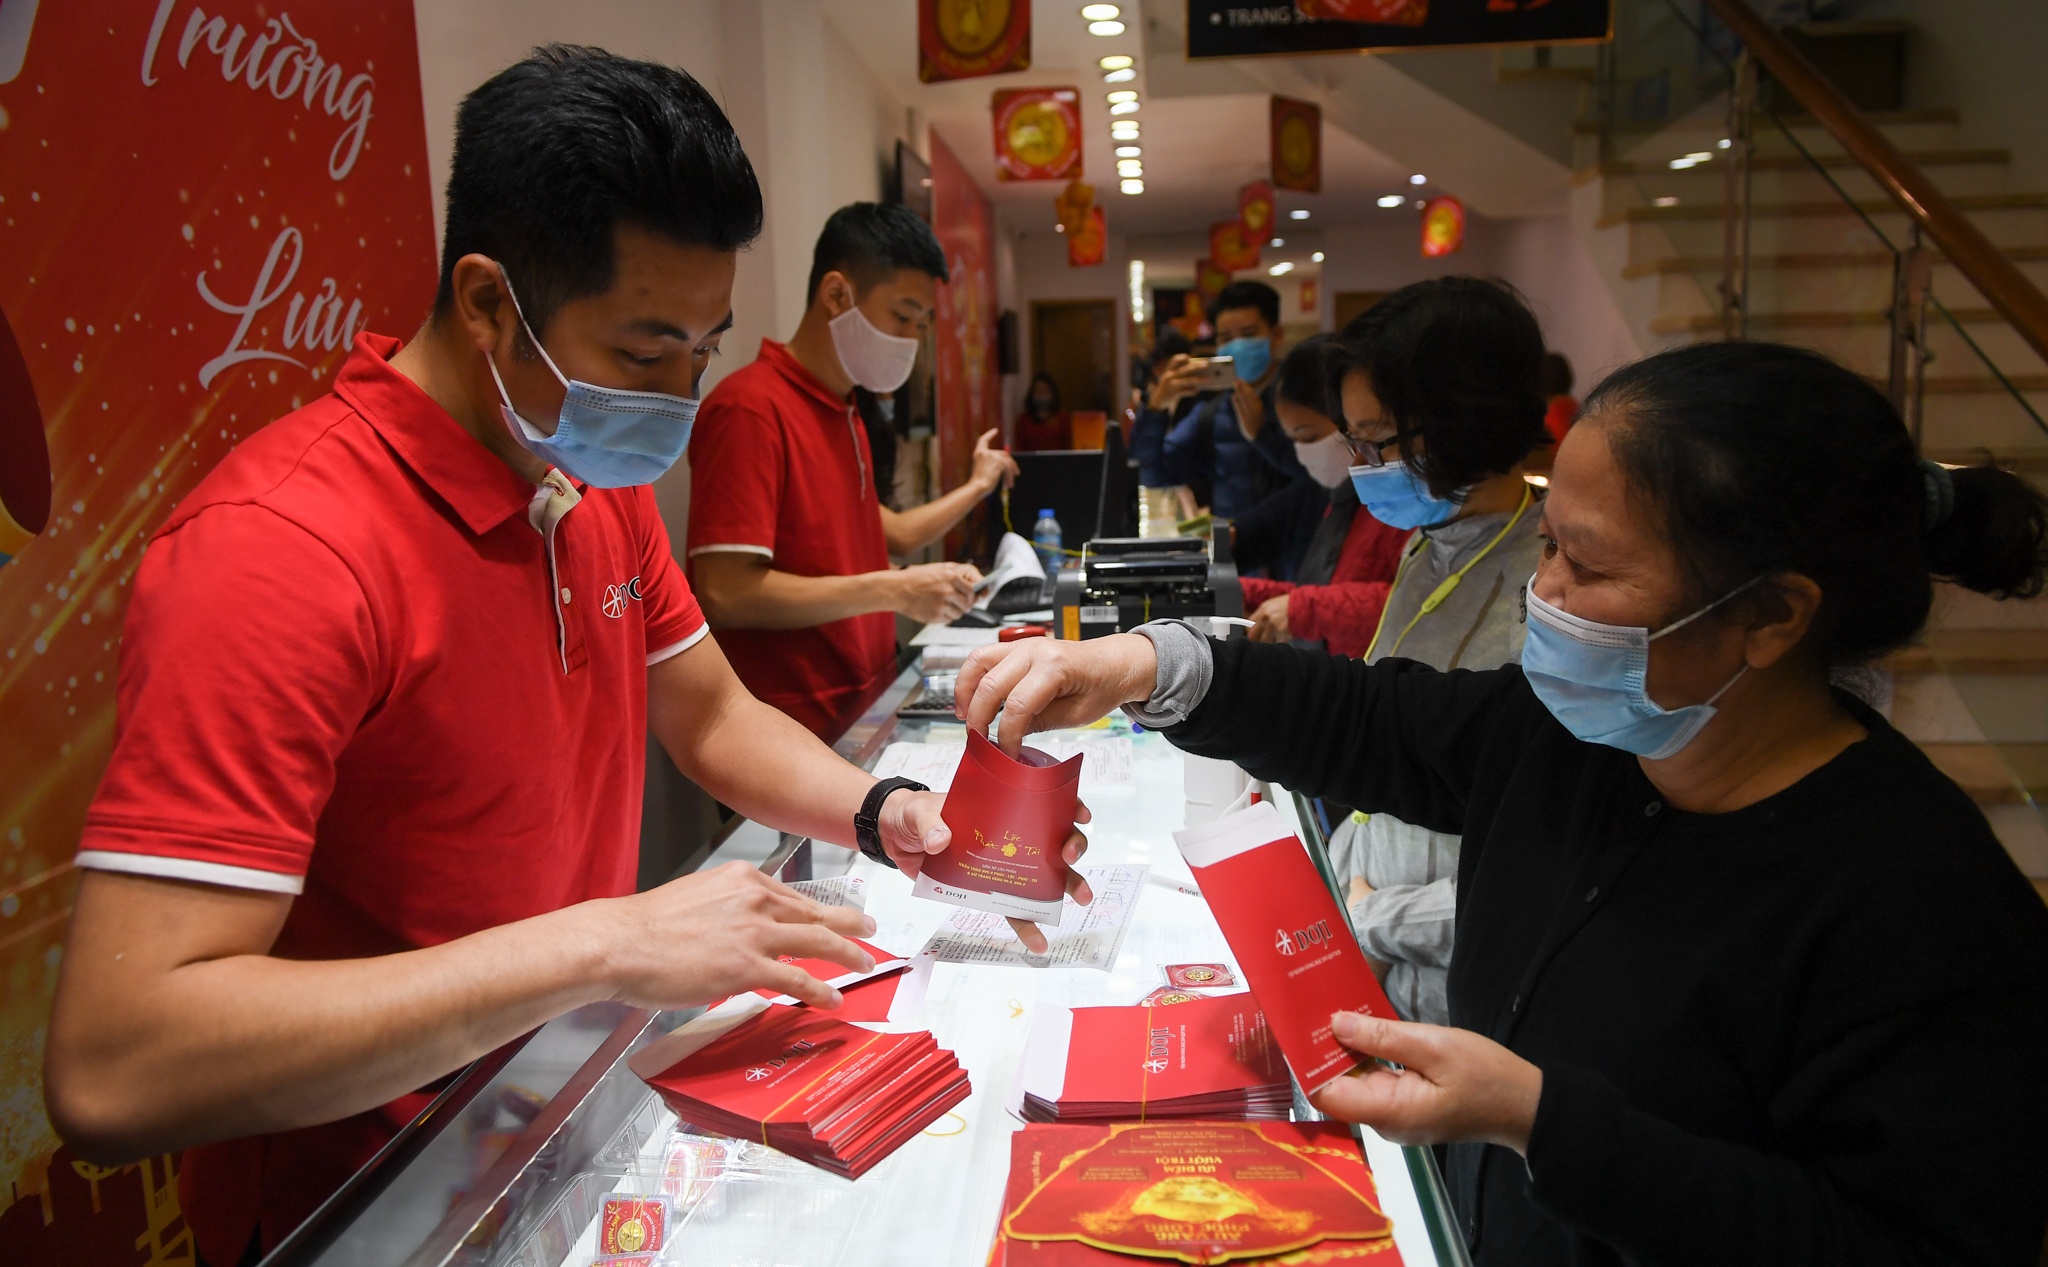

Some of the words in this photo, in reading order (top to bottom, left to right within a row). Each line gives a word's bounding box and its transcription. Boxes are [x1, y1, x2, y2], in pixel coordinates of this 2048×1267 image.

[1226, 6, 1292, 27] TRANG
[196, 226, 368, 390] Lưu
[945, 890, 967, 899] DOJI
[1293, 919, 1333, 950] DOJI
[766, 1038, 816, 1069] DOJI
[1150, 1027, 1176, 1057] DOJI
[1188, 1155, 1222, 1165] VƯỢT
